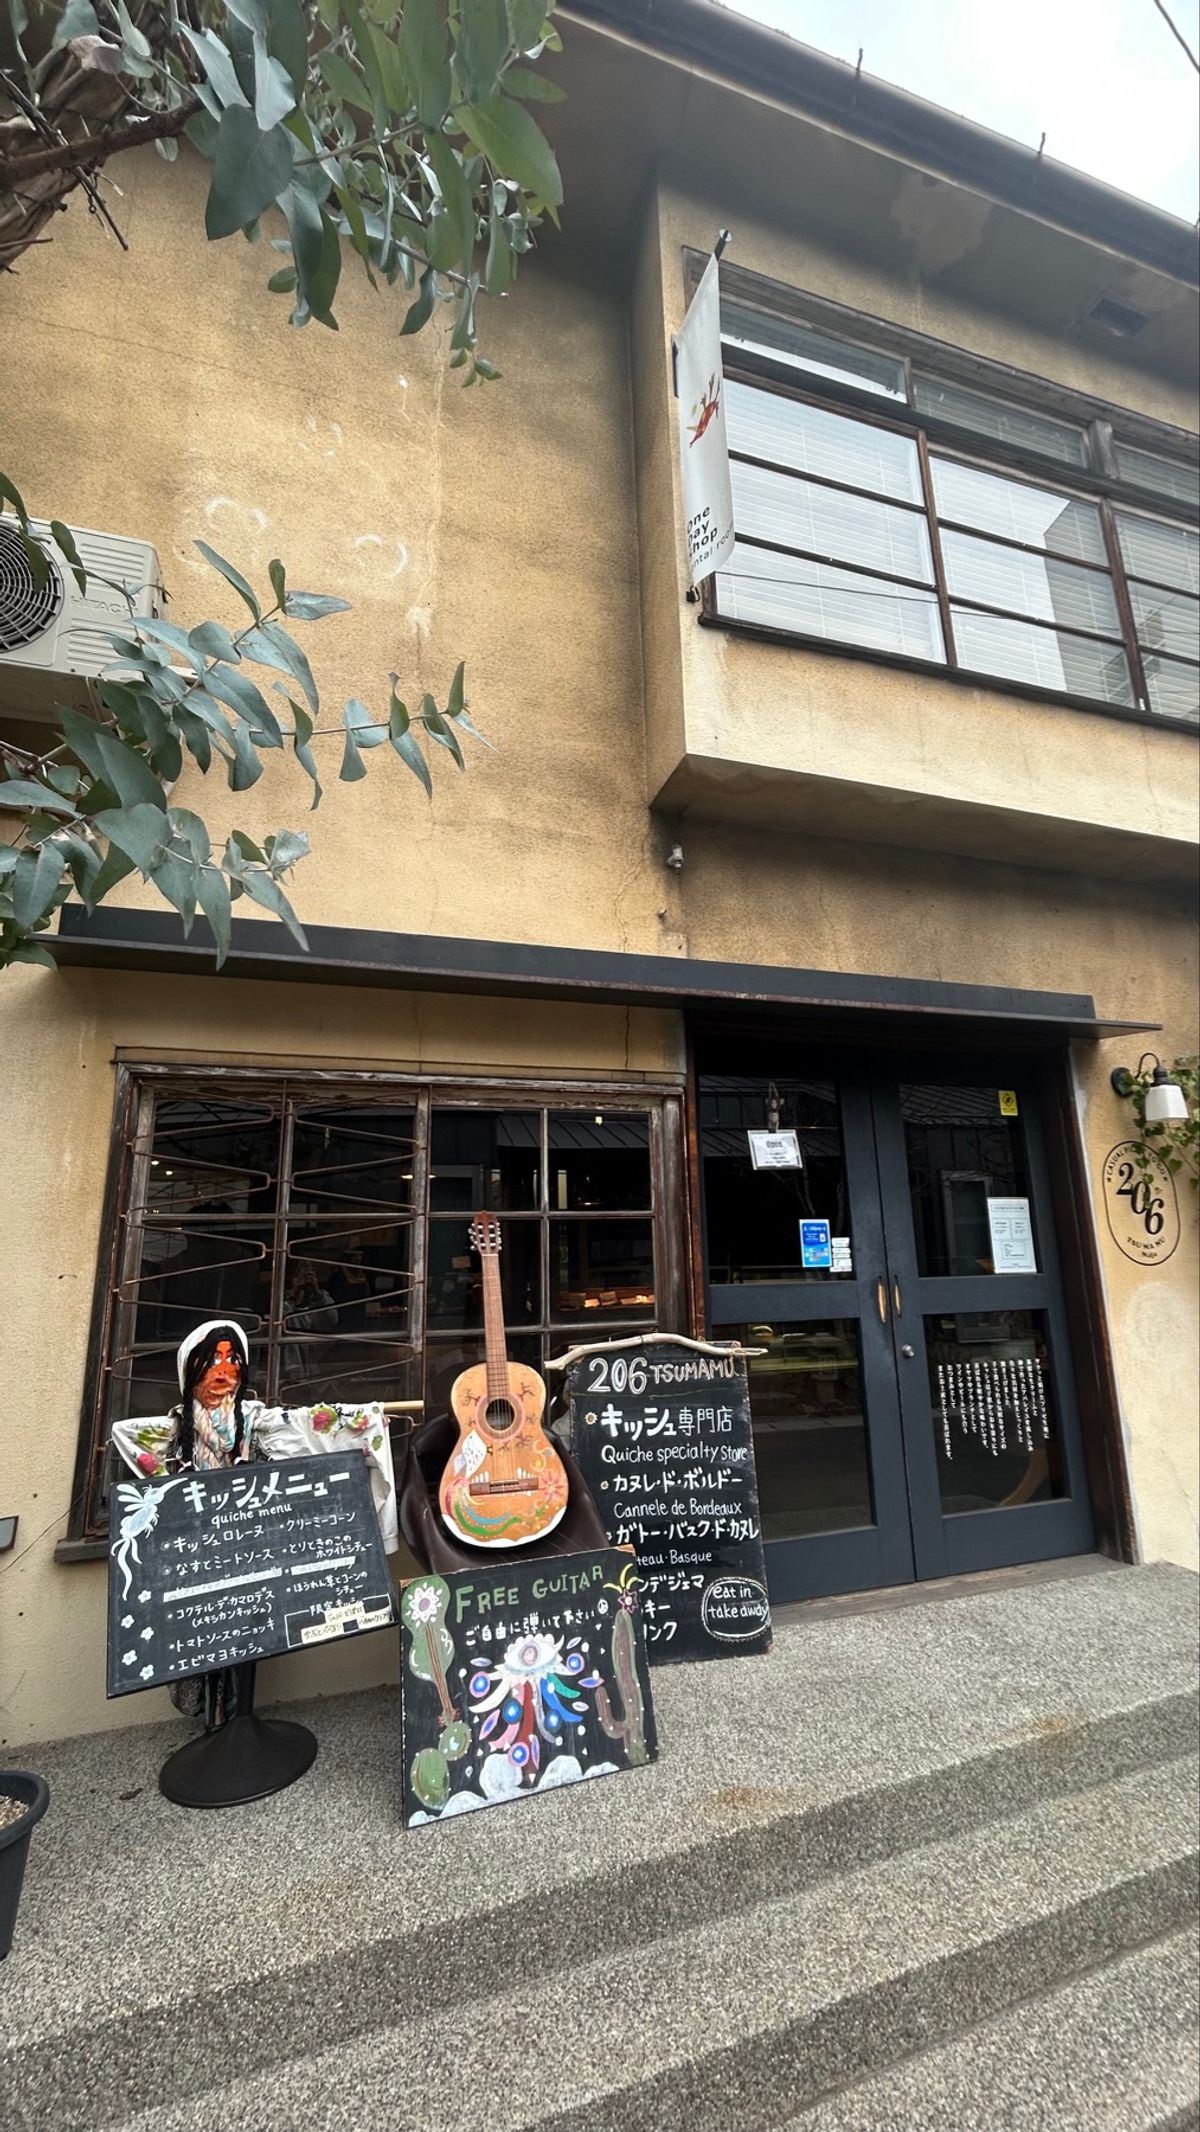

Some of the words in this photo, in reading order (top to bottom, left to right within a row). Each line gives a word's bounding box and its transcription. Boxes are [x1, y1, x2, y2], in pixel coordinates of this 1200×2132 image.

[1116, 1162, 1164, 1235] 206
[587, 1357, 648, 1395] 206
[650, 1357, 735, 1384] TSUMAMU
[601, 1403, 734, 1441] キッシュ専門店
[601, 1445, 654, 1465] Quiche
[657, 1441, 719, 1465] specialty
[182, 1471, 350, 1513] キッシュメニュー
[211, 1509, 254, 1529] quiche
[258, 1502, 293, 1518] menu
[286, 1511, 357, 1532] クリーミーコーン
[614, 1499, 669, 1518] Cannele
[671, 1499, 688, 1515] de
[689, 1498, 743, 1516] Bordeaux
[289, 1534, 352, 1555] とりときのこの
[315, 1542, 373, 1559] ホワイトシチュー
[176, 1549, 275, 1577] なすとミートソース
[293, 1570, 368, 1594] ほうれん草とコーンの
[335, 1584, 364, 1598] シチュー
[455, 1585, 520, 1624] FREE
[532, 1565, 604, 1599] GUITAR
[712, 1586, 737, 1599] eat
[740, 1585, 752, 1598] in
[708, 1603, 739, 1618] take
[740, 1604, 768, 1622] away
[176, 1616, 276, 1653] トマトソースのニョッキ
[465, 1608, 595, 1646] ご自由に弾いて下さい
[178, 1643, 265, 1672] エビマヨキッシュ
